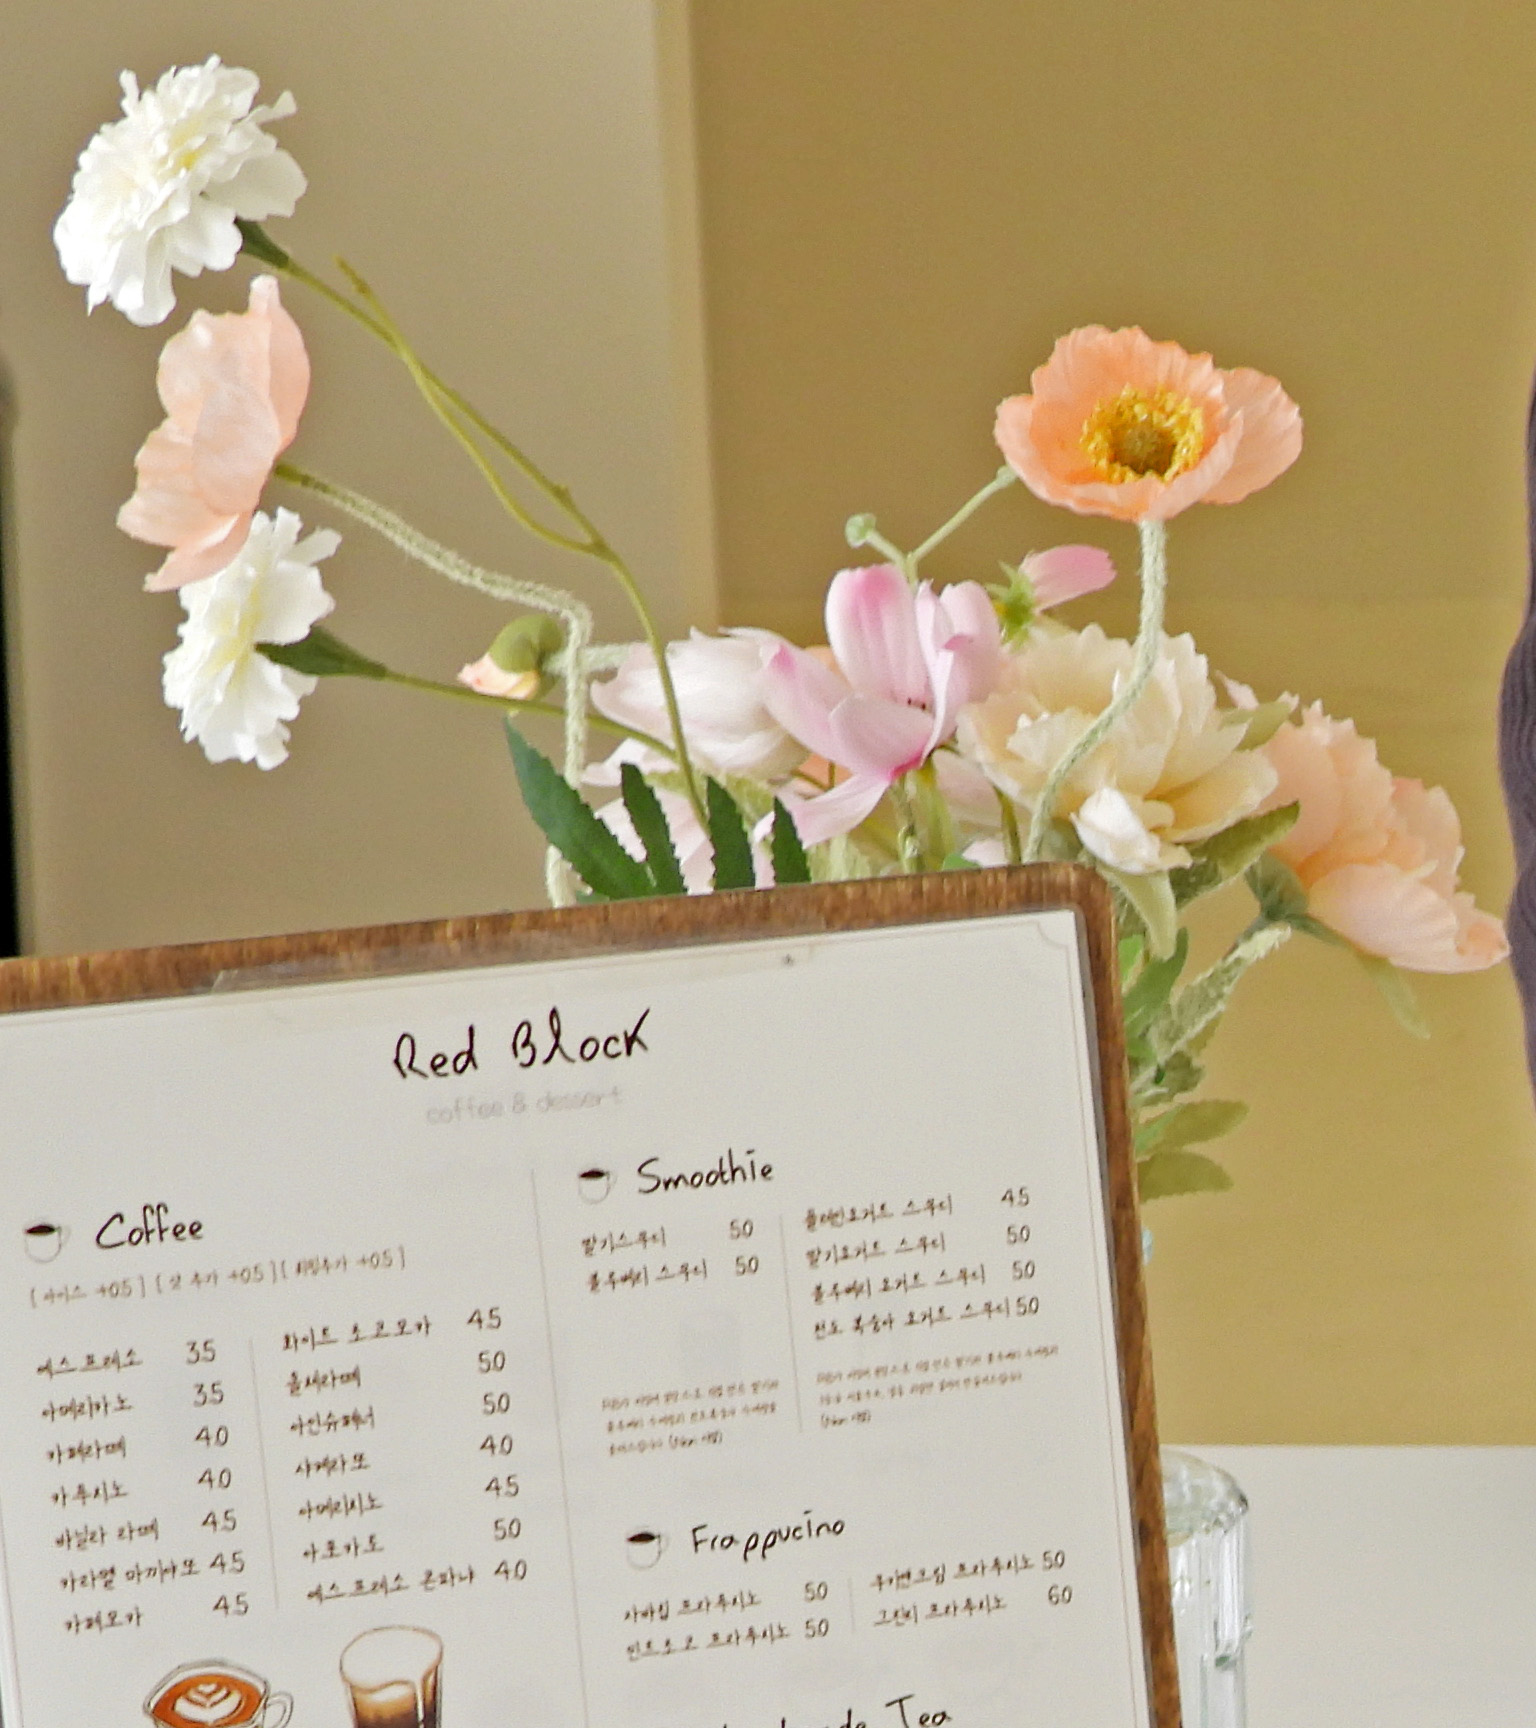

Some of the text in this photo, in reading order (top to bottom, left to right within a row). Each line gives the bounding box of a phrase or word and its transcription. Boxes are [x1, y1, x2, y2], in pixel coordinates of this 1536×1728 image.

[391, 1004, 650, 1080] Red Block
[636, 1146, 774, 1195] Smoothie
[94, 1200, 203, 1250] Coffee
[40, 1392, 133, 1423] 아메리카노
[690, 1510, 845, 1564] Frappucino
